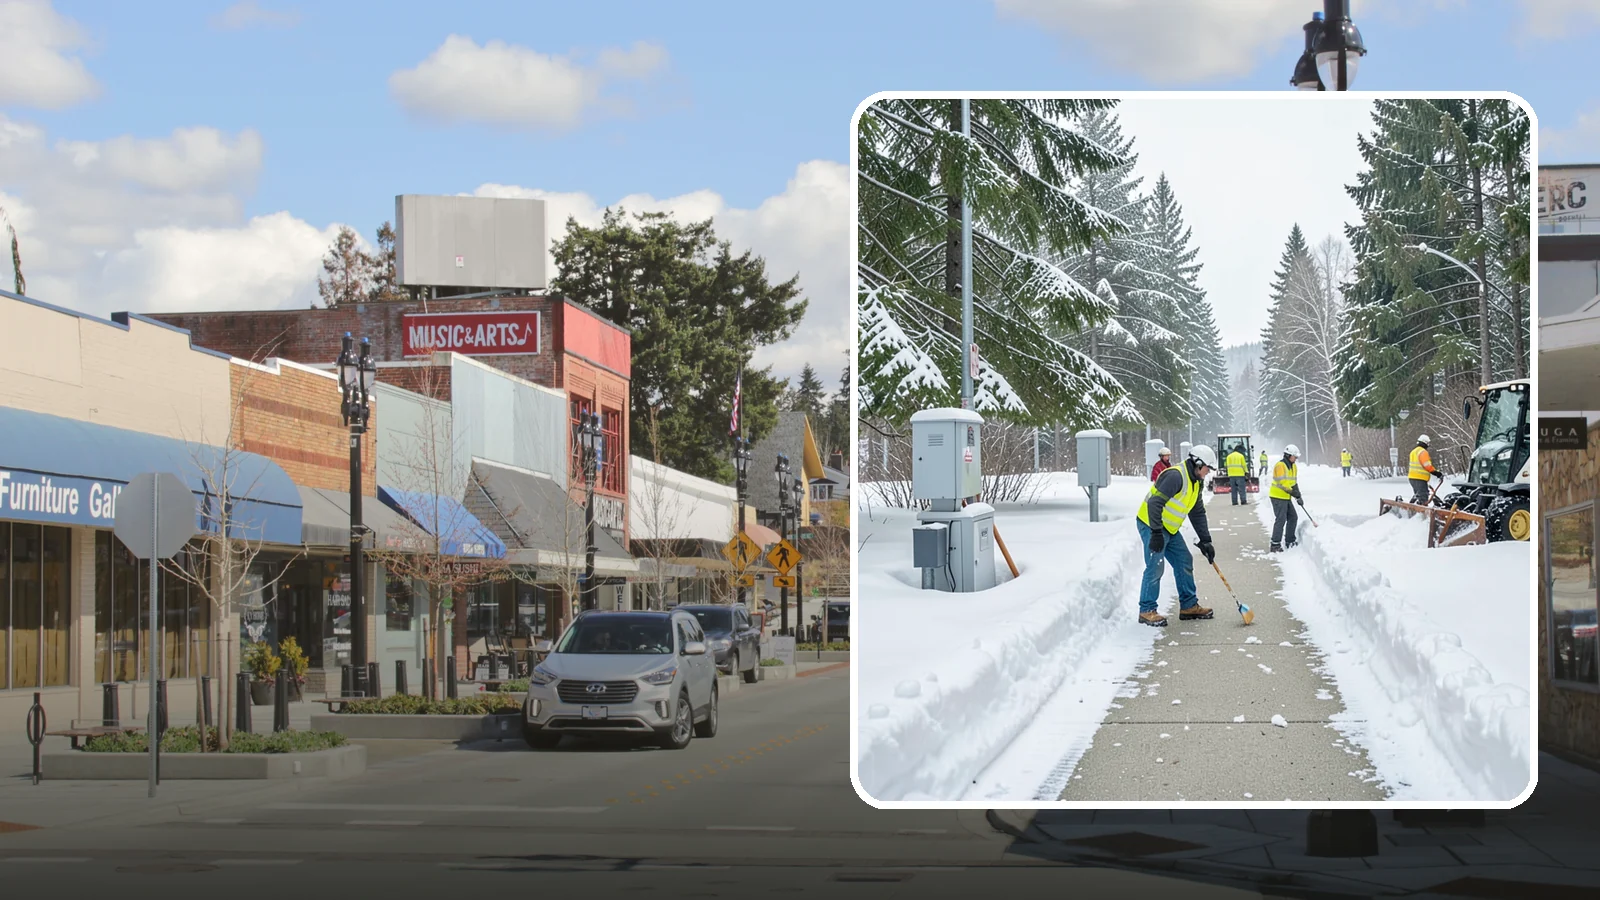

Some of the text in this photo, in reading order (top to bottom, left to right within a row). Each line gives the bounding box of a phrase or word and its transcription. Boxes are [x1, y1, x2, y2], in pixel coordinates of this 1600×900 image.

[1540, 427, 1577, 437] UGA
[0, 471, 79, 515] Furniture
[453, 563, 479, 574] SUSHI
